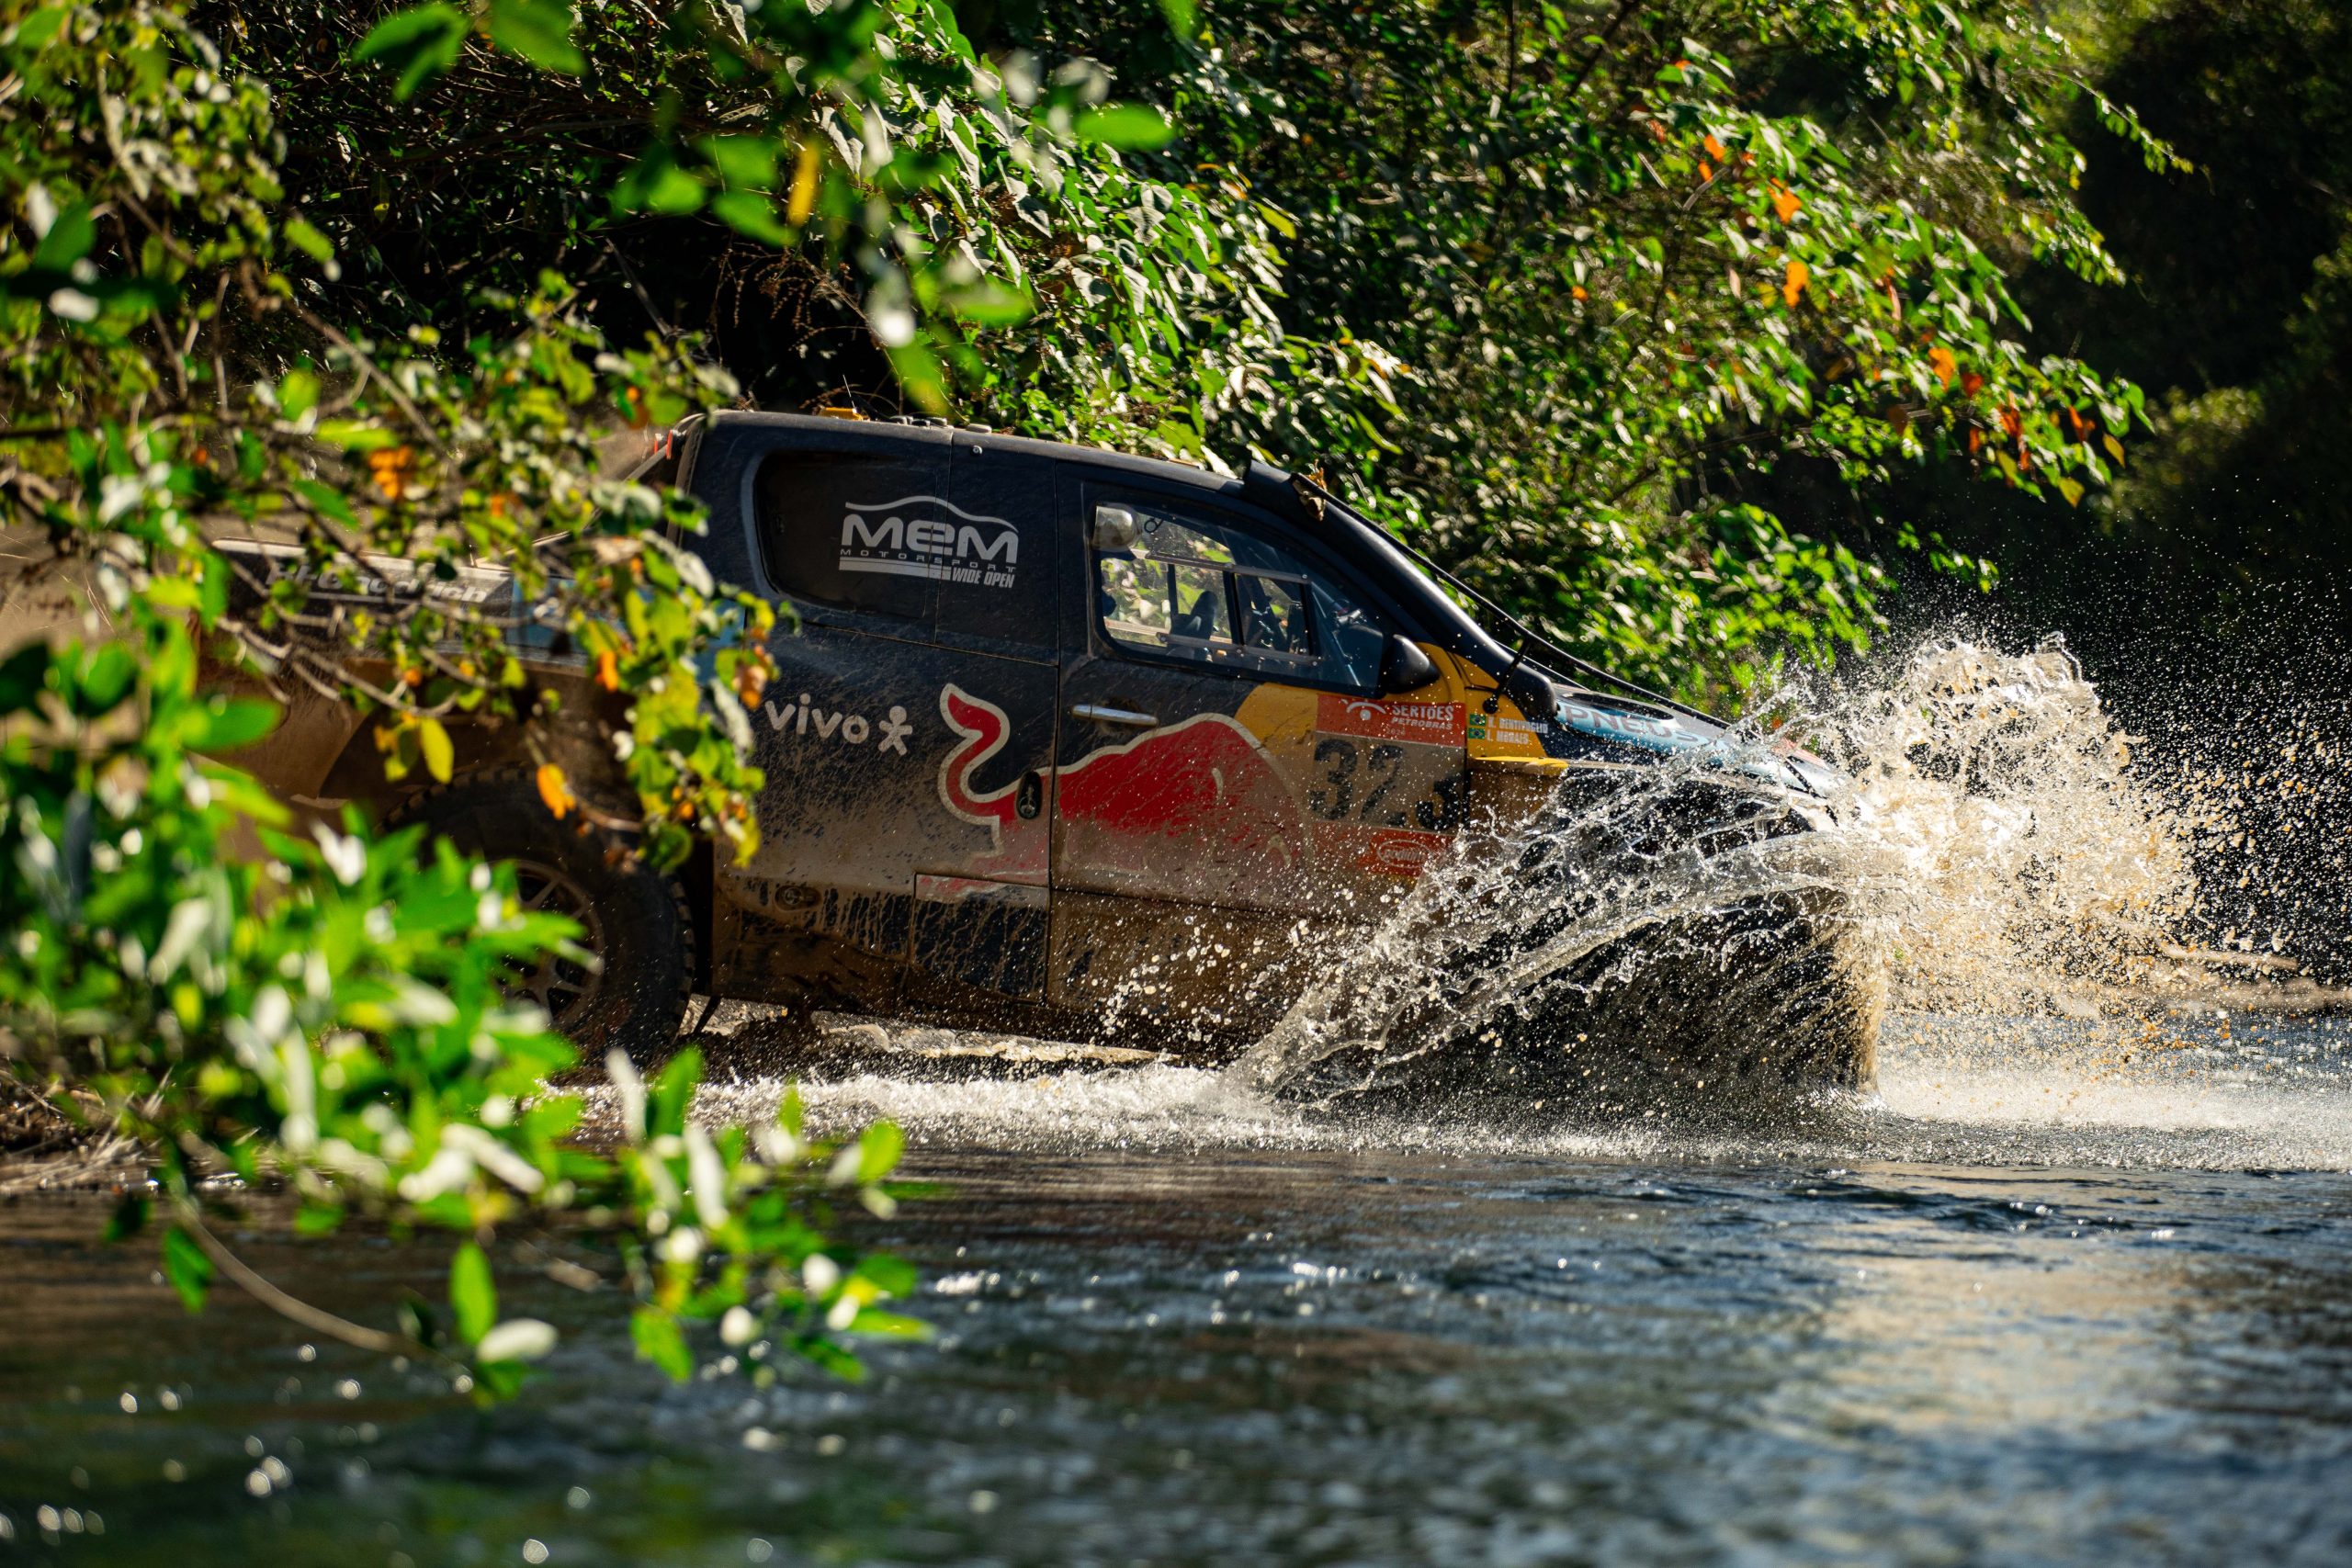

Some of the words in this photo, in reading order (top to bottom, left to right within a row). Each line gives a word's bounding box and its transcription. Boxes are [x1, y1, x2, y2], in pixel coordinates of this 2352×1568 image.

[840, 549, 1016, 572] MOTORSPORT
[952, 567, 982, 584] WIDE
[983, 570, 1015, 589] OPEN
[764, 693, 869, 744] vivo
[1391, 716, 1453, 730] PETROBRAS
[1565, 705, 1699, 742] PNEUS
